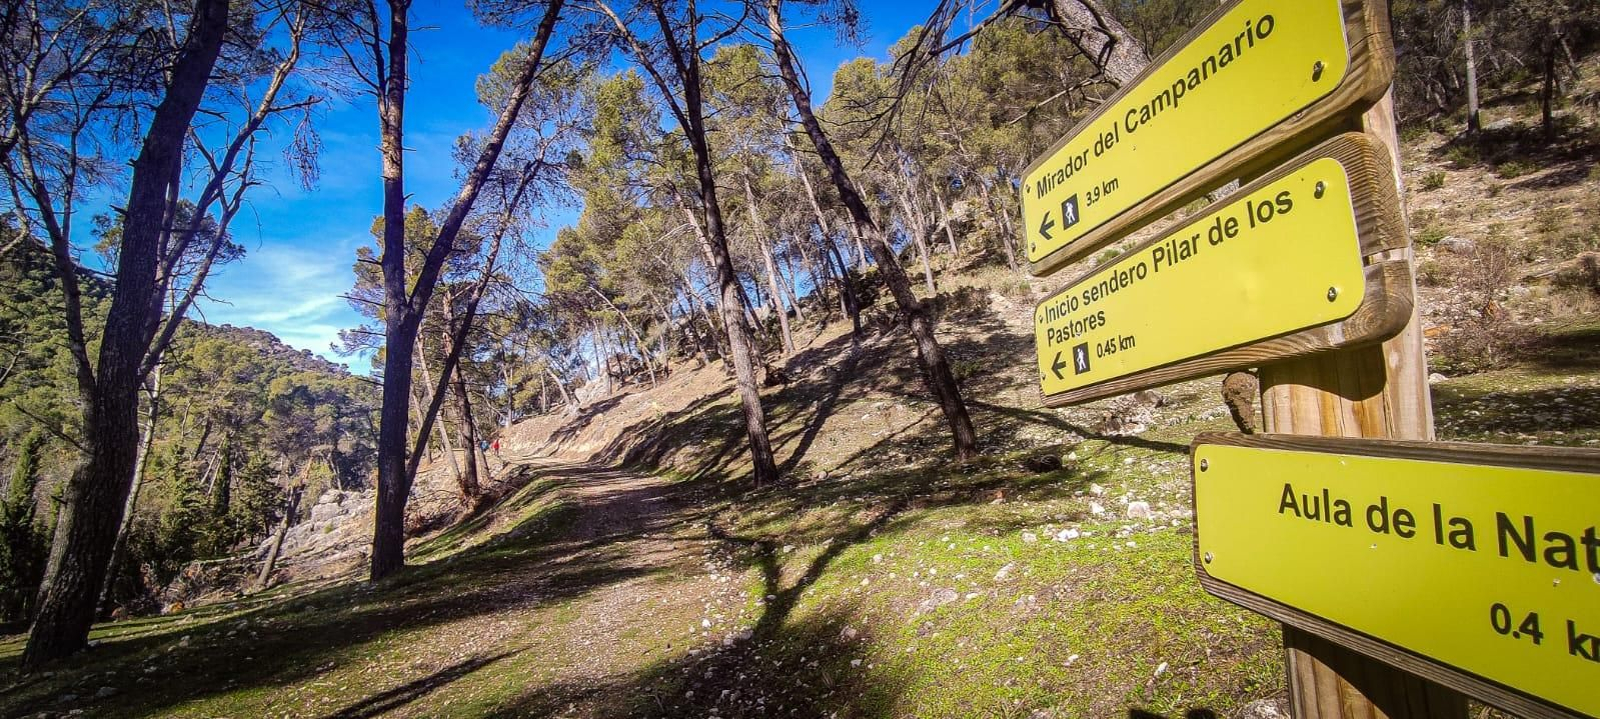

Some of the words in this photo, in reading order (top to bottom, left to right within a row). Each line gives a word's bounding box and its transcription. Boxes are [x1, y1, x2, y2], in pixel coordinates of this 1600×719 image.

[1036, 148, 1090, 200] Mirador
[1093, 121, 1120, 158] del
[1124, 14, 1275, 134] Campanario
[1085, 191, 1101, 208] 3.9
[1102, 178, 1120, 198] km
[1044, 295, 1079, 324] Inicio
[1082, 261, 1148, 307] sendero
[1151, 231, 1201, 274] Pilar
[1208, 216, 1240, 246] de
[1246, 190, 1294, 229] los
[1047, 309, 1107, 348] Pastores
[1096, 340, 1117, 358] 0.45
[1118, 334, 1136, 352] km
[1278, 482, 1354, 528] Aula
[1366, 495, 1417, 539] de
[1432, 502, 1477, 553] la
[1489, 602, 1545, 647] 0.4
